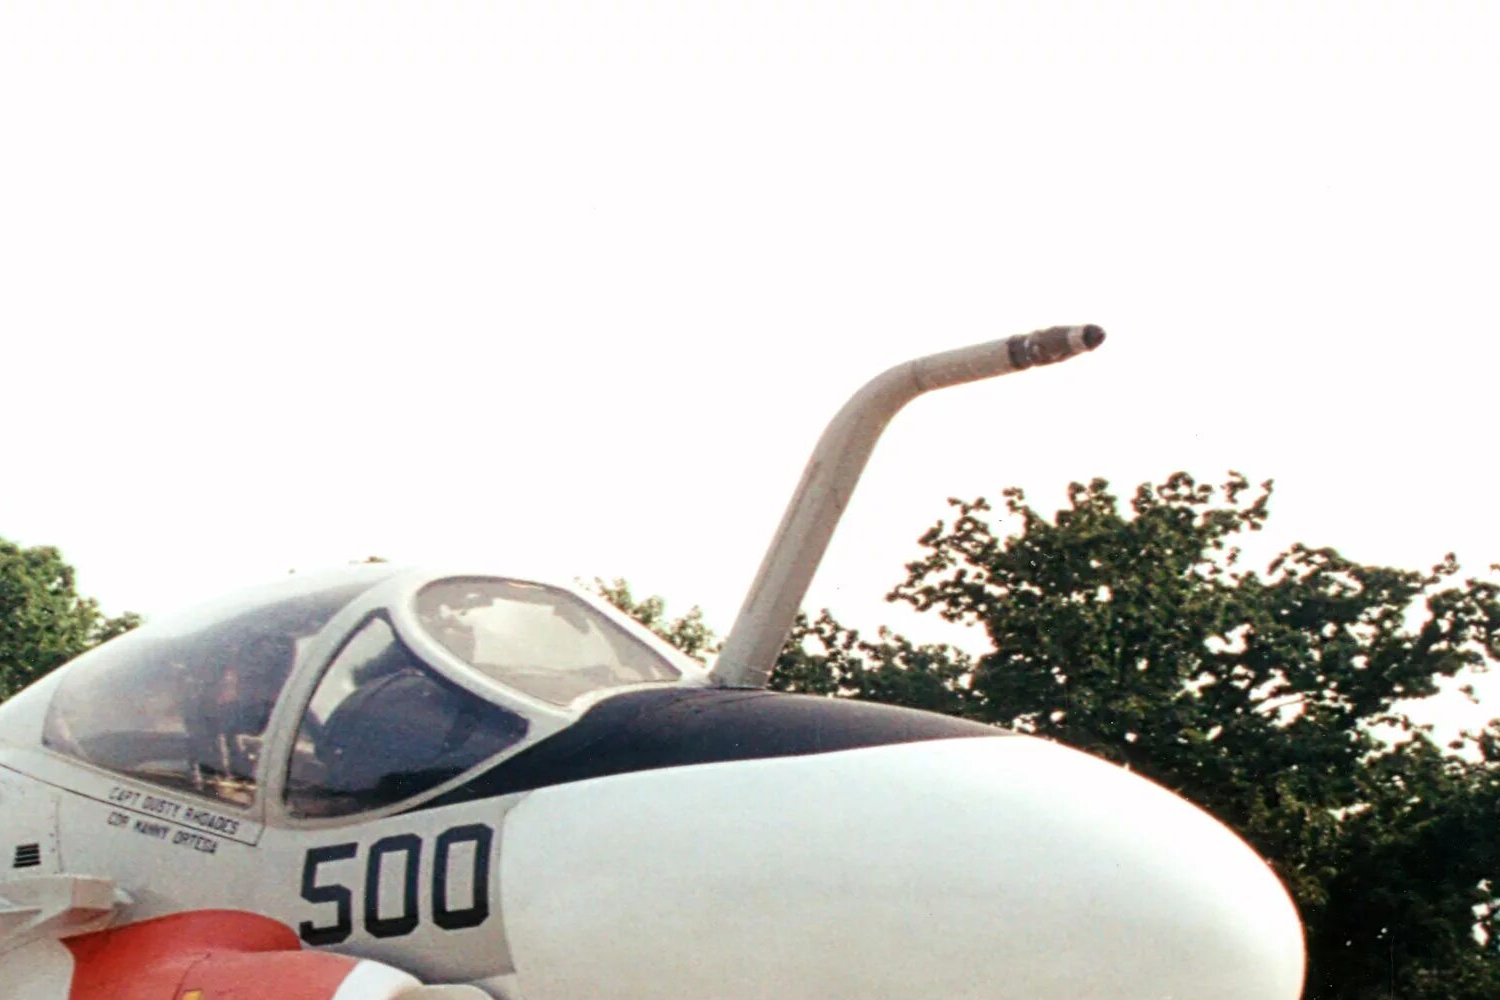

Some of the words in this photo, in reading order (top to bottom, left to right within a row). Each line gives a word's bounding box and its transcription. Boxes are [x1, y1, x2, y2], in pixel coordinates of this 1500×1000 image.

[108, 786, 141, 805] CAPT
[142, 796, 182, 817] DUSTY
[299, 822, 494, 946] 500
